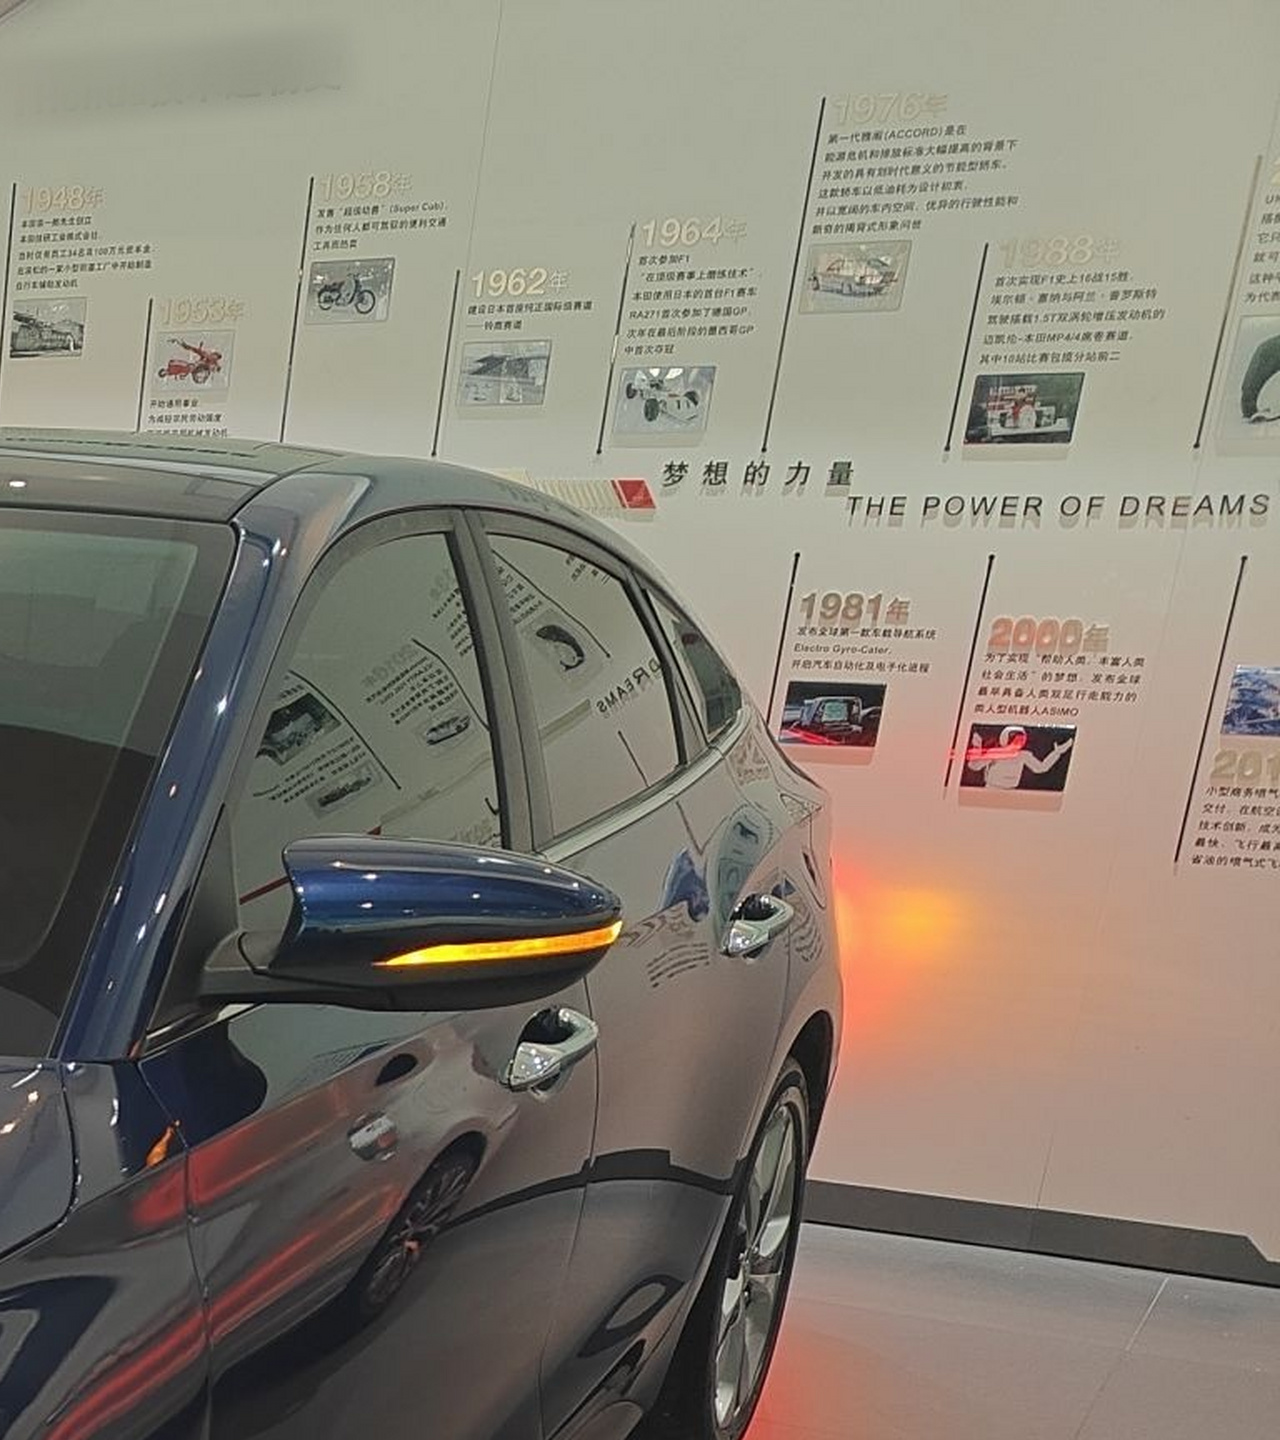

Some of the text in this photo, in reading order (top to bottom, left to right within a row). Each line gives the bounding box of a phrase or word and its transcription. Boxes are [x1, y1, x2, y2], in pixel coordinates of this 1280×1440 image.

[472, 268, 568, 297] 1962年
[662, 460, 855, 487] 梦想的力量
[848, 494, 1270, 517] THE POWER OF DREAMS
[800, 592, 911, 622] 1981年
[988, 617, 1109, 649] 2000年
